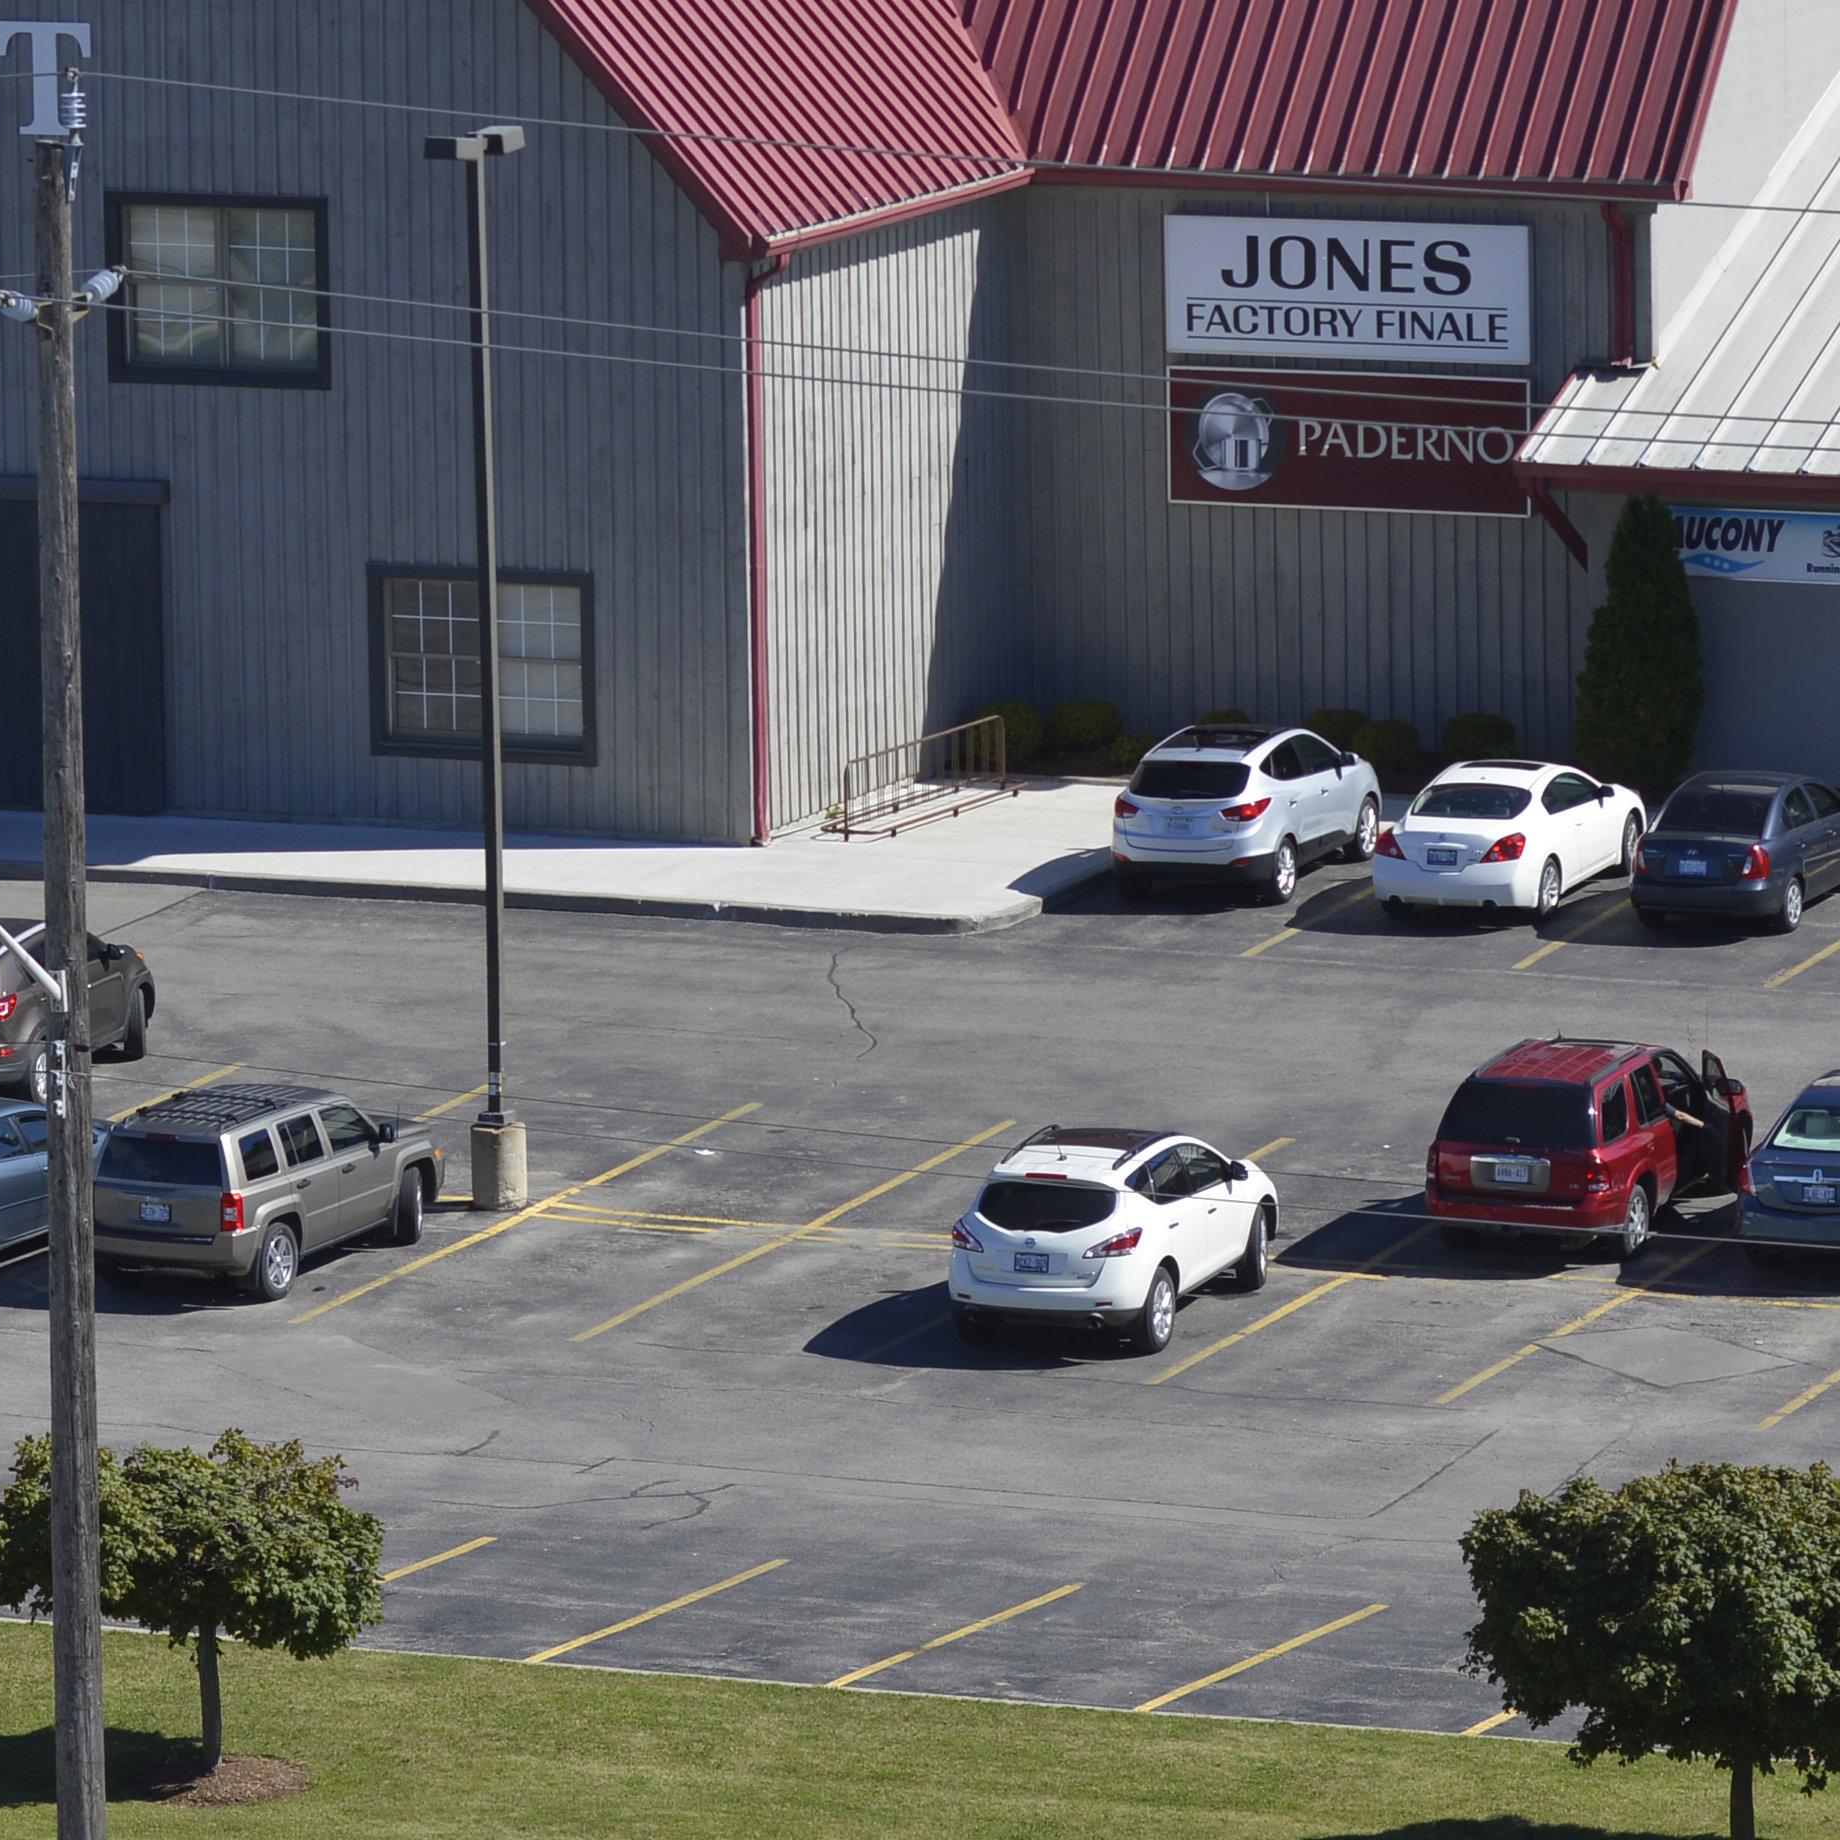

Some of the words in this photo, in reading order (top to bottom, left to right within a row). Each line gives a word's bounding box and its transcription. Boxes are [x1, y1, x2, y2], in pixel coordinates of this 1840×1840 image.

[1221, 235, 1471, 296] JONES
[1186, 302, 1362, 338] FACTORY
[1376, 309, 1508, 344] FINALE
[1298, 417, 1514, 464] PADERNO
[1673, 515, 1785, 552] AUCONY
